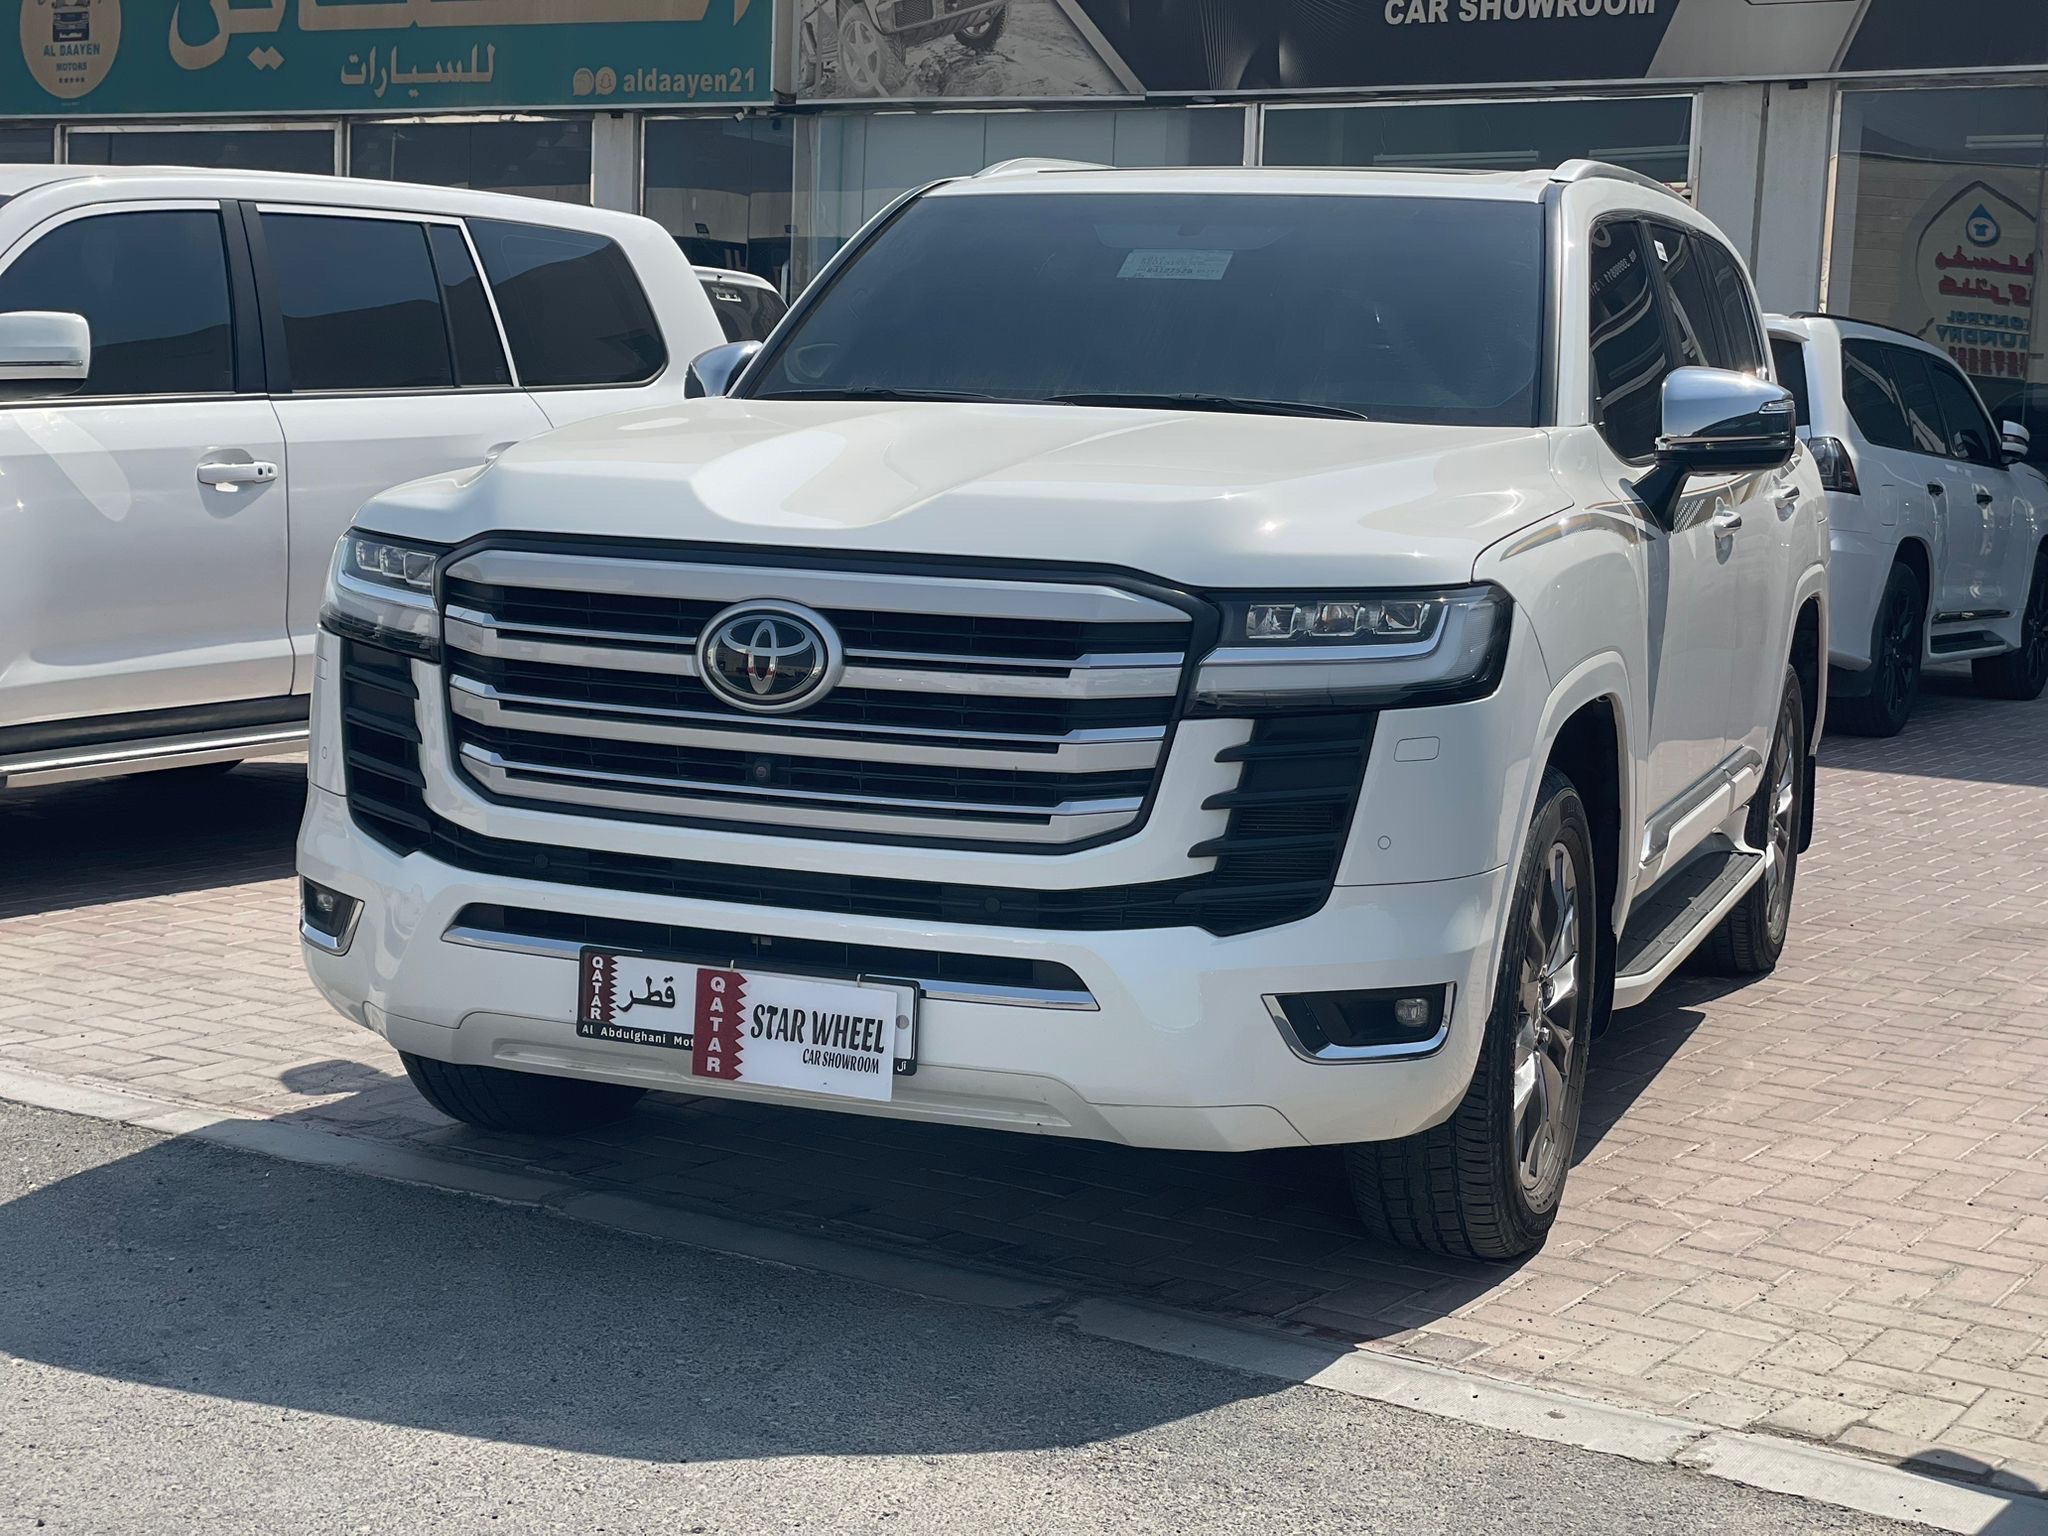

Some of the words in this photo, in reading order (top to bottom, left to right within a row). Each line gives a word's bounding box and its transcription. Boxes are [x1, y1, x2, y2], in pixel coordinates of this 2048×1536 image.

[1384, 0, 1448, 25] CAR
[1458, 0, 1656, 22] SHOWROOM
[43, 45, 56, 56] AL
[60, 44, 101, 56] DAAYEN
[56, 62, 87, 72] MOTORS
[340, 43, 496, 98] للسيارات
[623, 67, 755, 98] aldaayen21
[590, 956, 604, 1020] QATAR
[616, 975, 676, 1013] قطر
[582, 1024, 594, 1035] Al
[600, 1027, 666, 1044] Abdulghani
[674, 1035, 694, 1048] Mot
[706, 976, 726, 1073] QATAR
[750, 1004, 806, 1044] STAR
[812, 1010, 885, 1054] WHEEL
[802, 1048, 821, 1066] CAR
[821, 1051, 879, 1074] SHOWROOM
